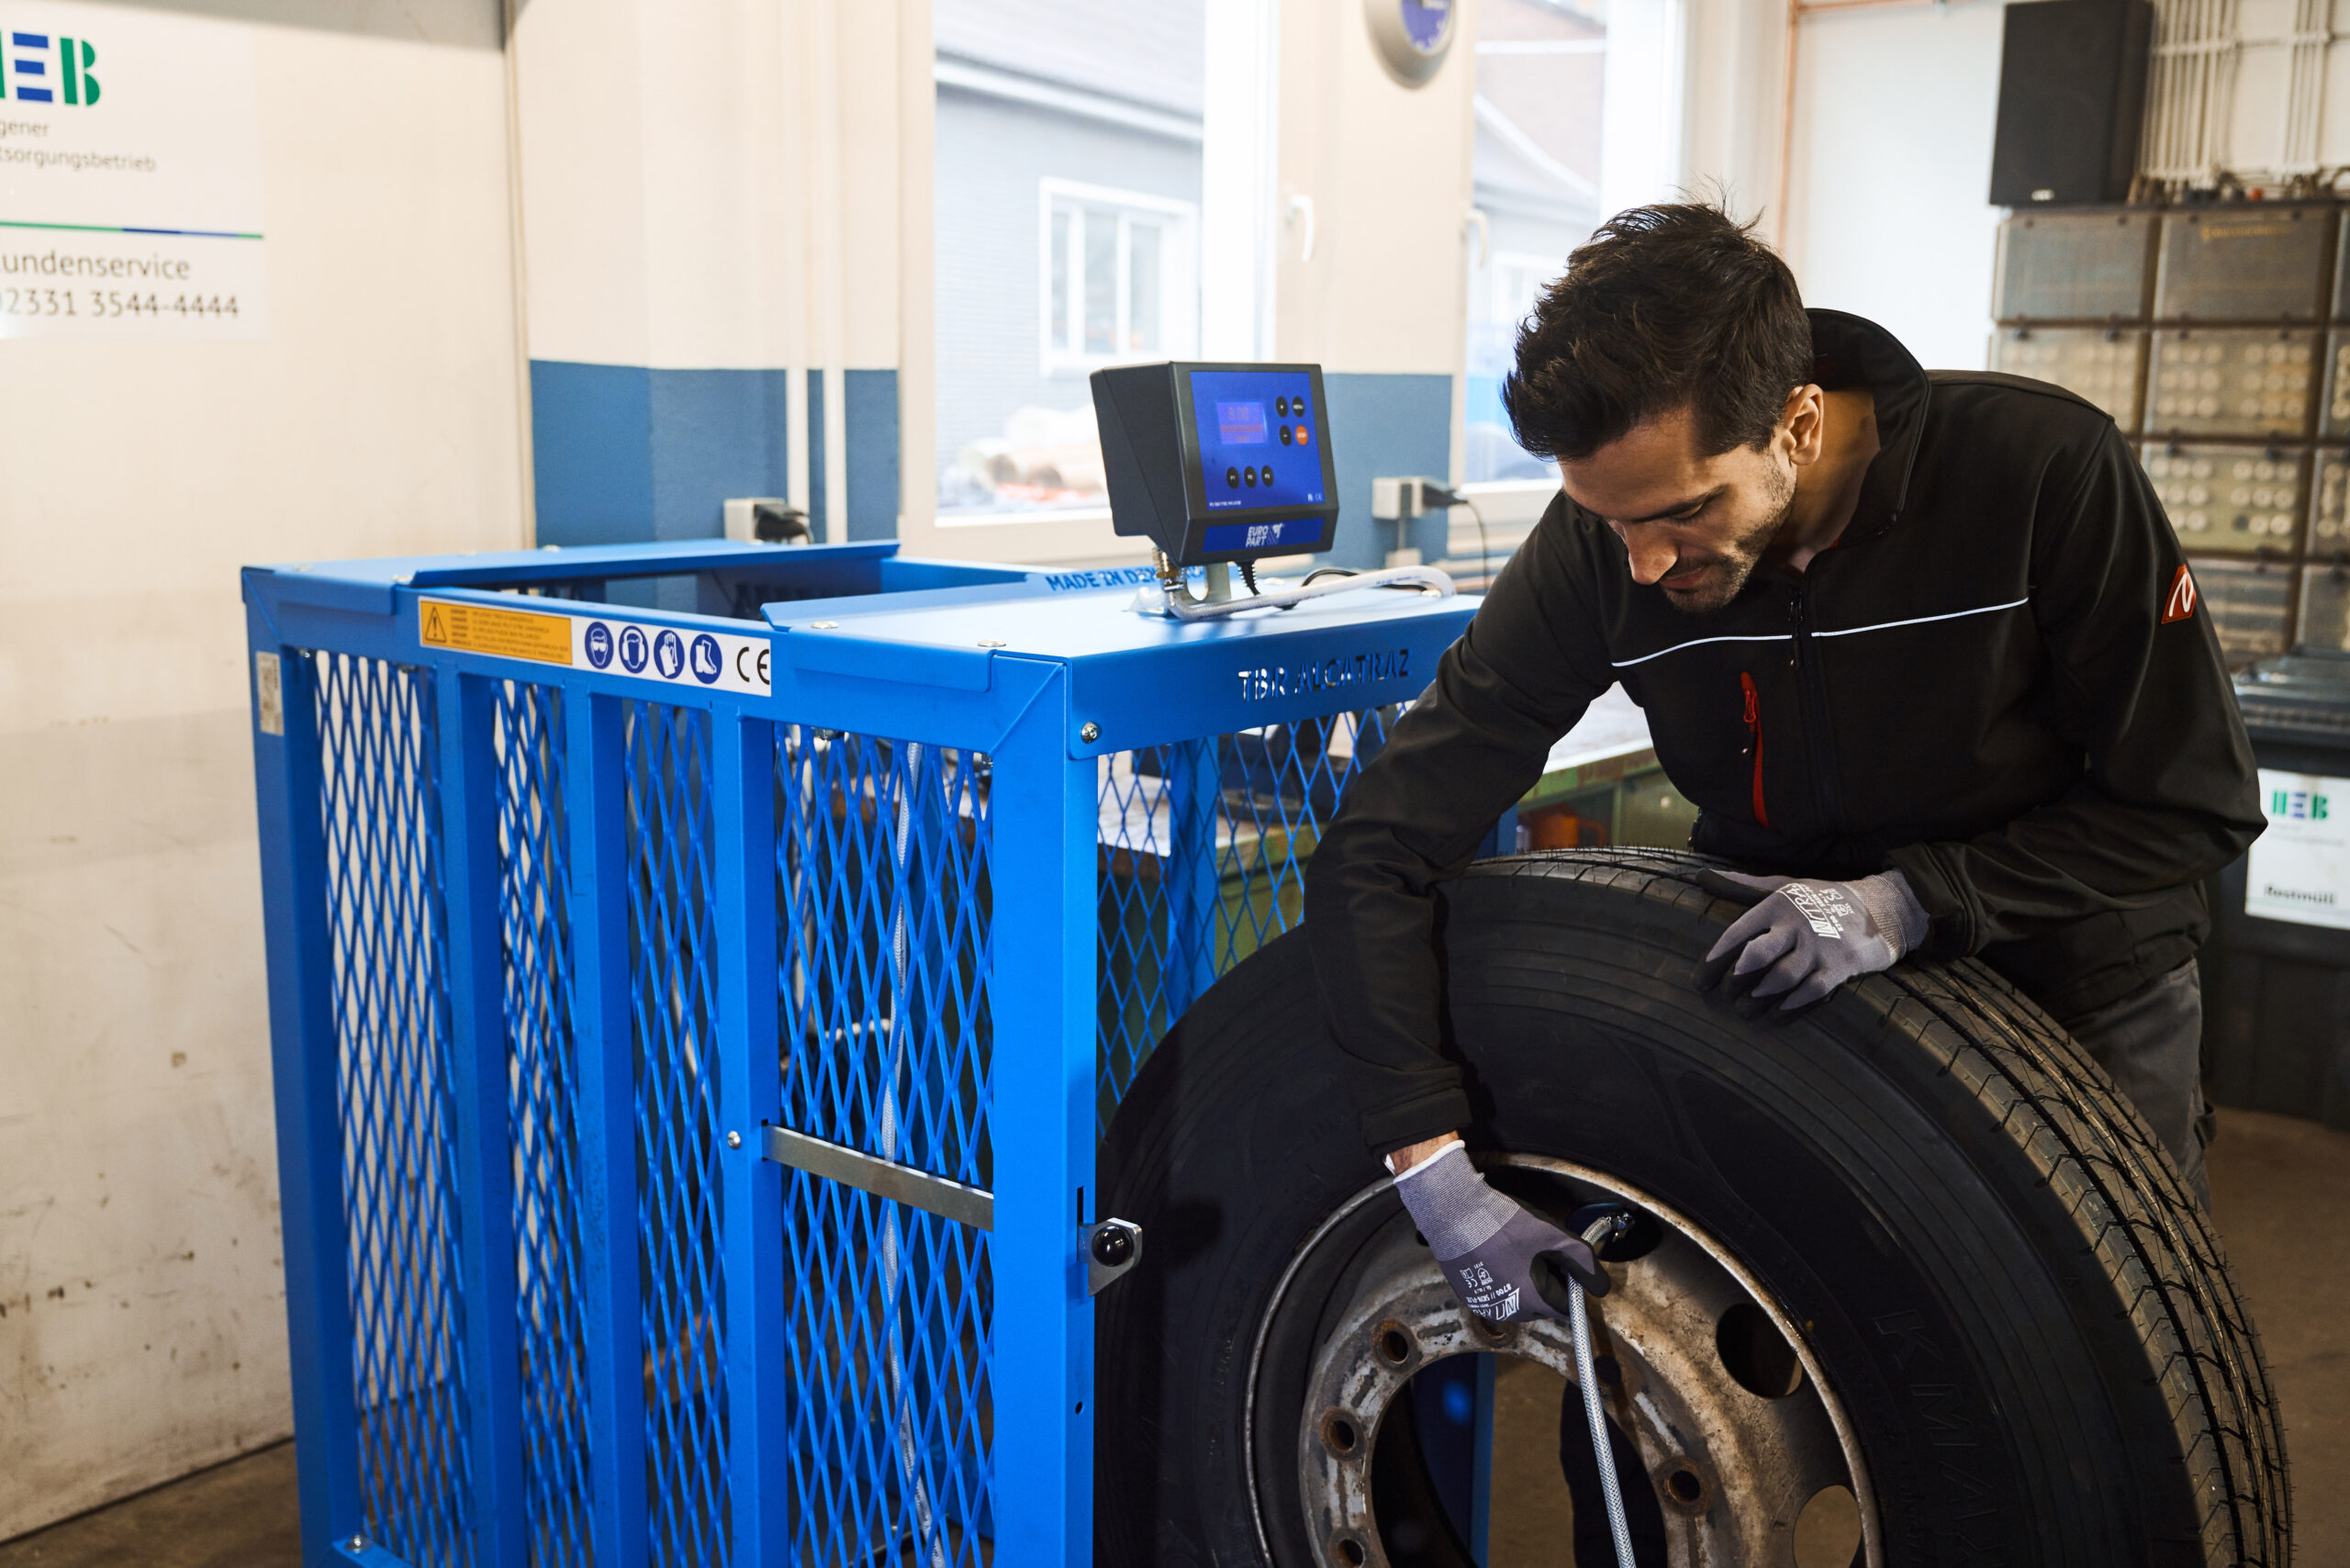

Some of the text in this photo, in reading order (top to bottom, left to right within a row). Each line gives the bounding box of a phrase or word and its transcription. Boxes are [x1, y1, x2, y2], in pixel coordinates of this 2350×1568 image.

[0, 28, 101, 106] EB
[89, 290, 240, 319] 3544-4444
[1246, 535, 1267, 547] PART
[1248, 525, 1269, 536] EURO
[1046, 573, 1101, 591] MADE
[1100, 568, 1125, 586] IN
[1238, 648, 1413, 702] TBR ALCATRAZ
[1495, 1283, 1512, 1296] 8700
